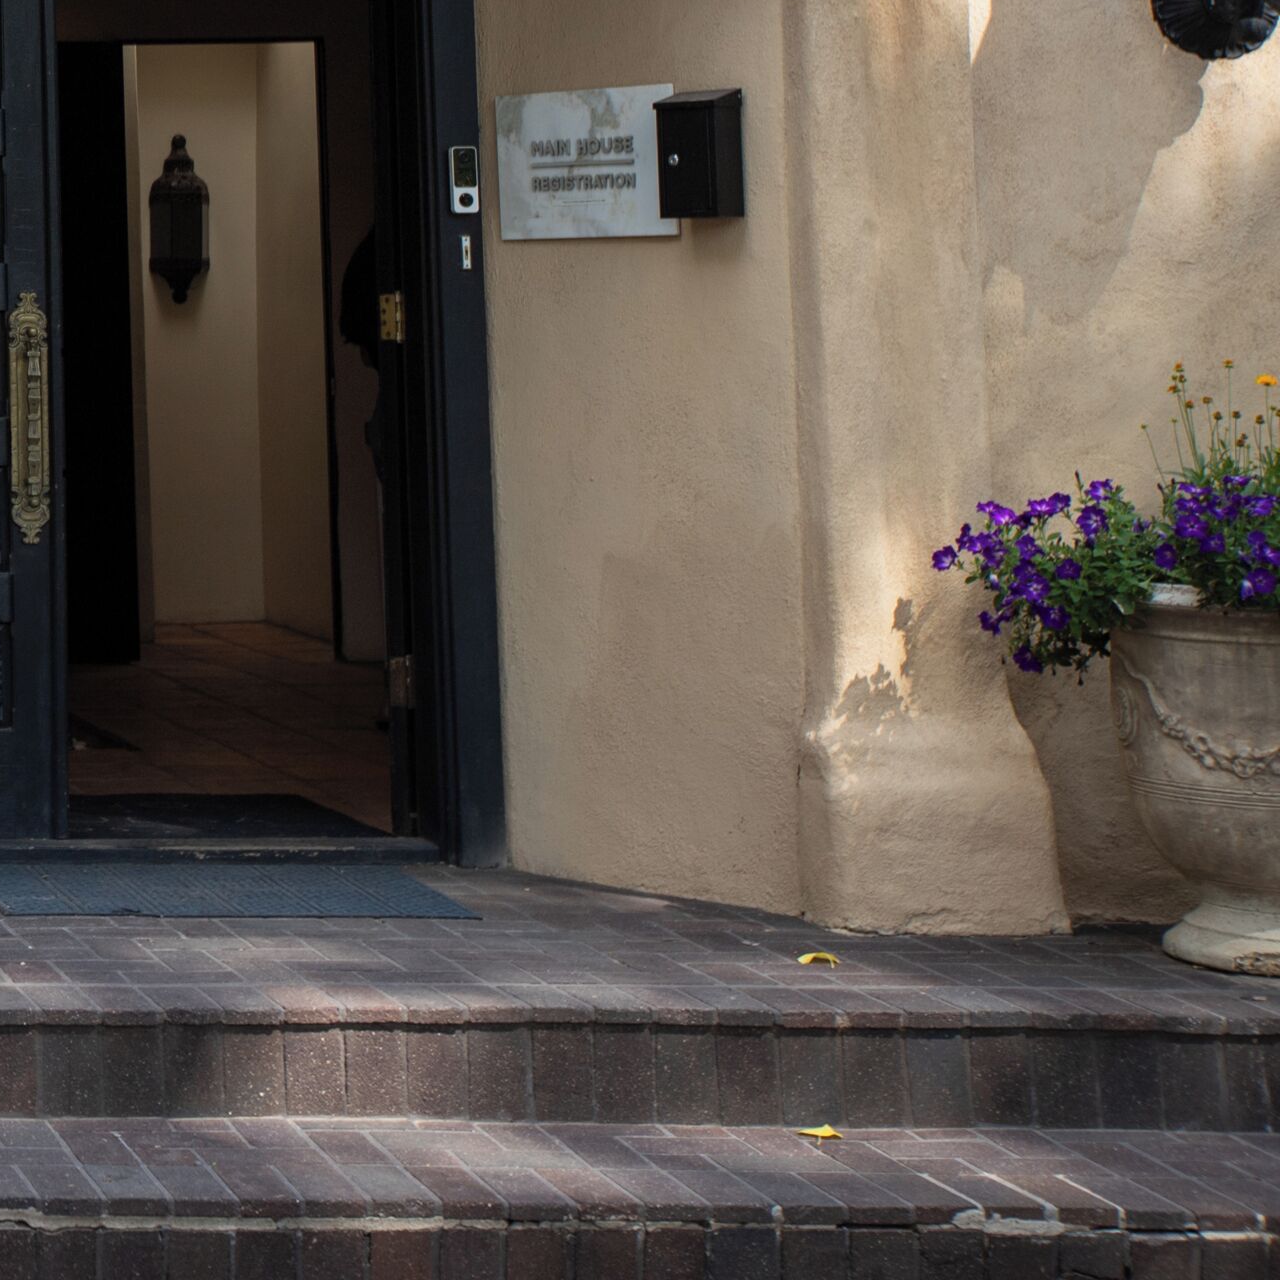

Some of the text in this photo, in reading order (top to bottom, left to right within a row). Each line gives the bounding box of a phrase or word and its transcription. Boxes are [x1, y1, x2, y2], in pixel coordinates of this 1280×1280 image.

[530, 135, 634, 157] MAIN HOUSE
[531, 172, 637, 192] REGISTRATION
